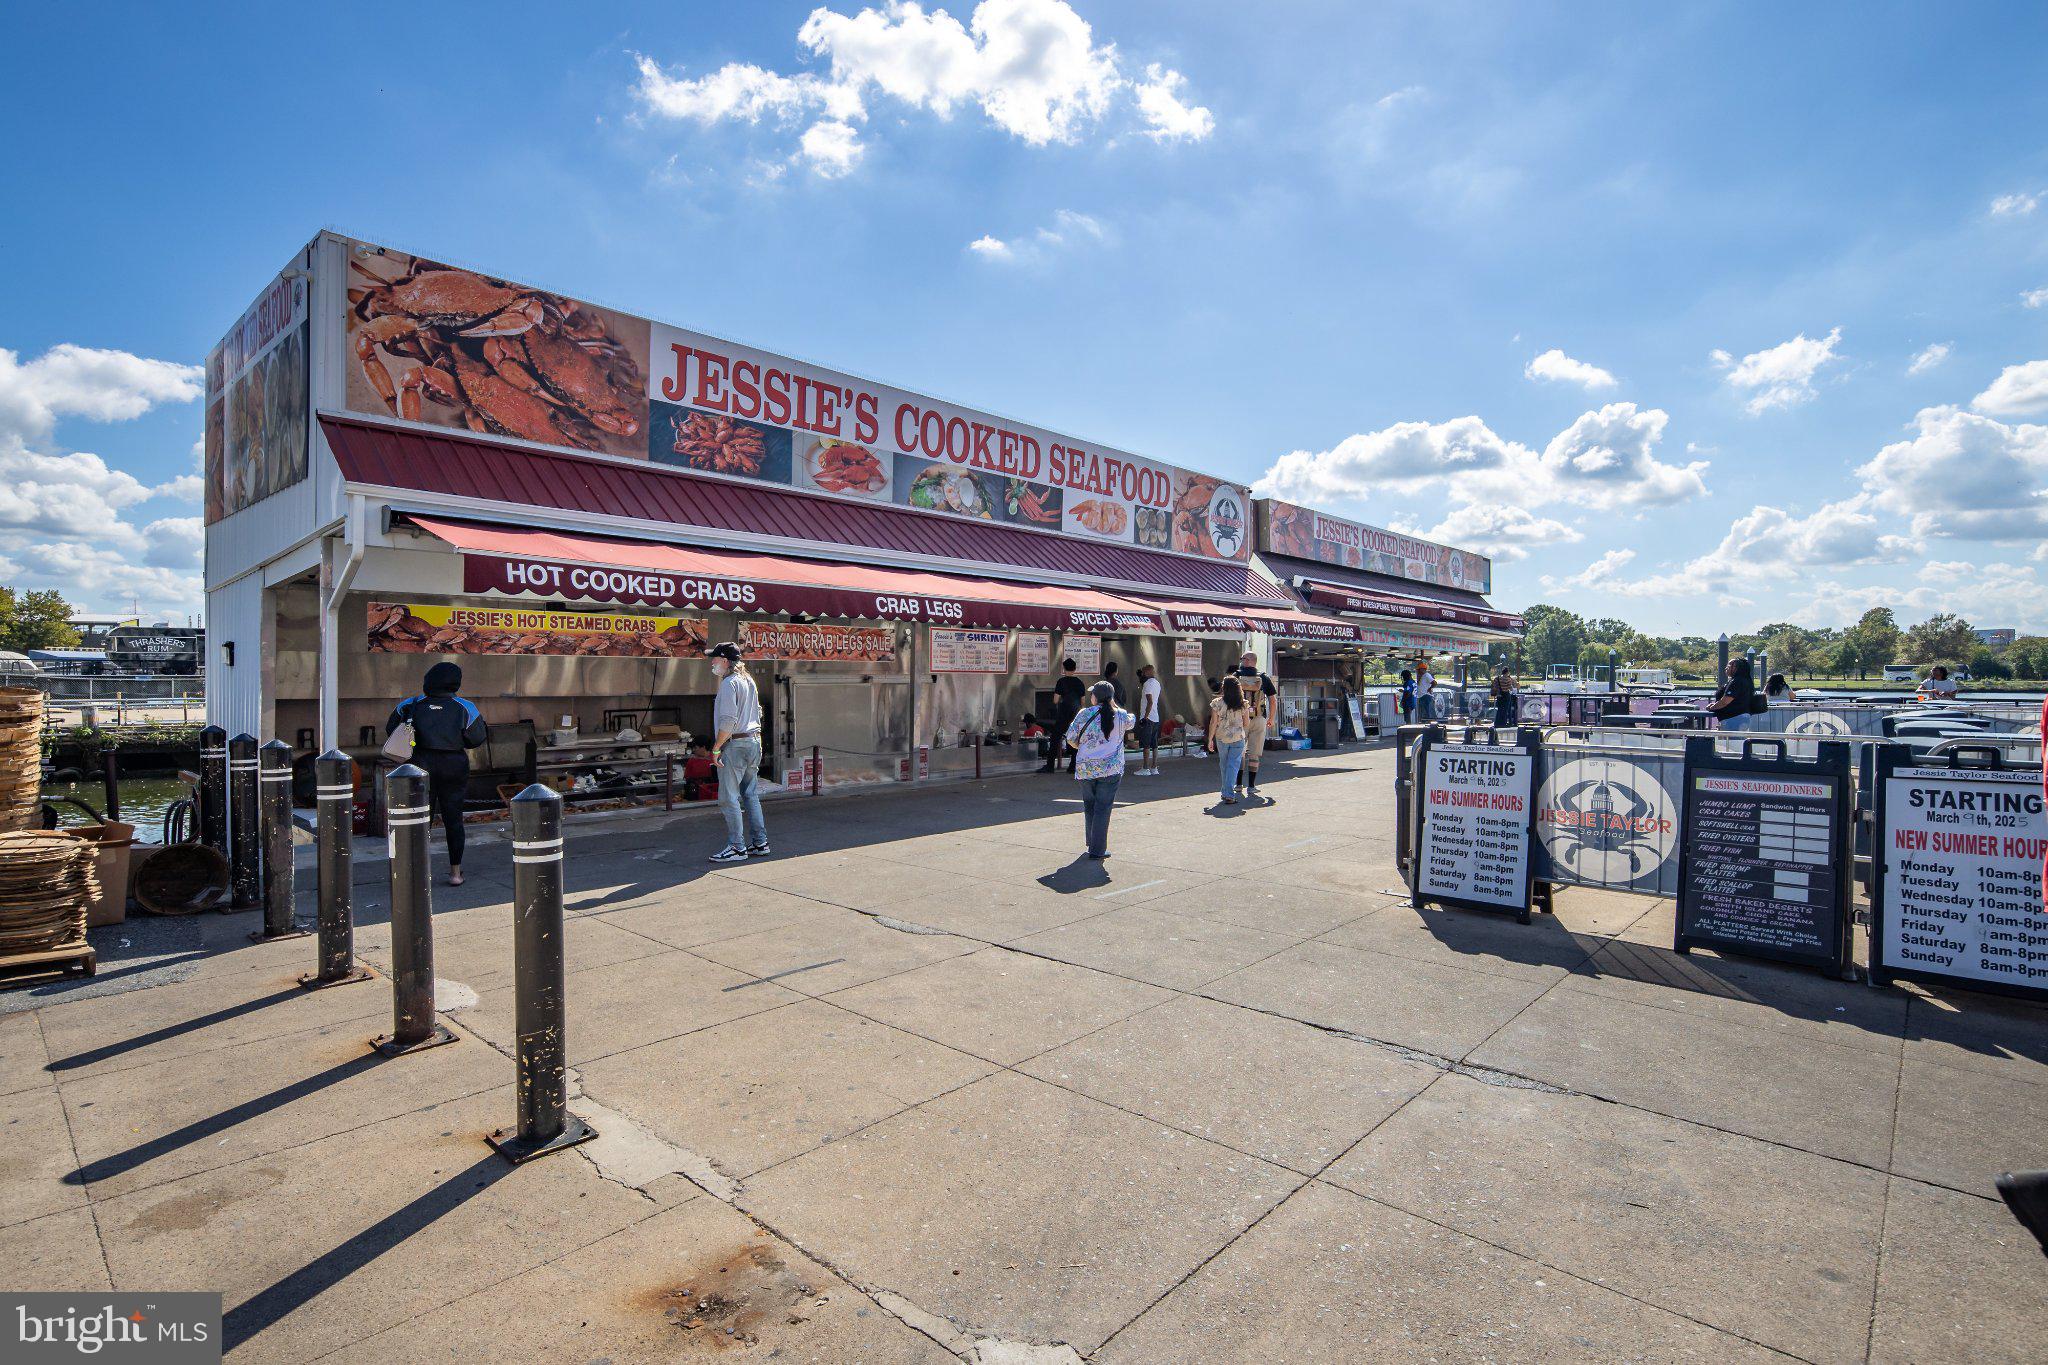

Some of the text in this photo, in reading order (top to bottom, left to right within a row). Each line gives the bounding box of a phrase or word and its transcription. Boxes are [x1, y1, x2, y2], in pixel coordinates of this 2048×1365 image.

[662, 343, 1171, 508] JESSIE'S COOKED SEAFOOD
[1316, 517, 1437, 564] JESSIE'S COOKED SEAFOOD
[506, 562, 756, 603] HOT COOKED CRABS
[875, 596, 963, 619] CRAB LEGS
[448, 610, 656, 633] JESSIE'S HOT STEAMED CRABS
[1069, 611, 1151, 626] SPICED SHRIMP
[1176, 614, 1245, 628] MAINE LOBSTER
[1270, 621, 1286, 633] BAR
[967, 633, 1005, 643] SHRIMP
[1293, 622, 1354, 637] HOT COOKED CRABS
[129, 637, 186, 648] THRASHER'S
[744, 630, 891, 651] ALASKAN CRAB LEGS SALE
[1439, 758, 1516, 777] STARTING
[1912, 769, 2039, 781] Jessie Taylor Seafood
[1448, 775, 1468, 785] March
[1705, 780, 1823, 796] JESSIE'S SEAFOOD DINNERS
[1430, 789, 1523, 812] NEW SUMMER HOURS
[1699, 800, 1756, 810] JUMBO LUMP
[1761, 802, 1826, 813] Sandwich Platters
[1909, 788, 2043, 815] STARTING
[1432, 812, 1520, 829] Monday 10am-8pm
[1539, 808, 1672, 834] JESSIE TAYLOR
[1699, 808, 1751, 818] CRAB CAKES
[1927, 810, 1960, 824] March
[1995, 814, 2029, 828] 2025
[1432, 823, 1519, 840] Tuesday 10am-8pm
[1580, 827, 1626, 839] Seafood
[1698, 820, 1739, 830] SOFTSHELL
[1431, 834, 1519, 852] Wednesday 10am-8pm
[1698, 831, 1756, 843] FRIED OYSTERS
[1895, 829, 2047, 860] NEW SUMMER HOUR
[1431, 845, 1518, 864] Thursday 10am-8pm
[1698, 844, 1742, 854] FRIED FISH
[1430, 856, 1455, 868] Friday
[1695, 860, 1751, 872] FRIED SHRIMP
[1738, 857, 1768, 865] FLOUNDER
[1430, 867, 1513, 887] Saturday 8am-8pm
[1703, 869, 1737, 878] PLATTER
[1901, 859, 2042, 883] Monday 10am-8p
[1429, 879, 1513, 898] Sunday 8am-8pm
[1694, 877, 1753, 890] FRIED SCALLOP
[1703, 885, 1736, 894] PLATTER
[1901, 874, 2042, 899] Tuesday 10am-8p
[1702, 894, 1813, 914] FRESH BAKED DESERTS
[1715, 902, 1742, 910] SMITH
[1901, 889, 2046, 916] Wednesday 10am-8p
[1777, 916, 1814, 925] BANANA
[1901, 903, 1968, 923] Thursday
[1713, 919, 1749, 930] PLATTERS
[1750, 925, 1775, 934] Served
[1795, 932, 1818, 940] Choice
[1901, 918, 1945, 936] Friday
[1783, 935, 1804, 943] French
[1901, 933, 2048, 962] Saturday 8am-8pm
[1901, 949, 2048, 978] Sunday 8am-8pm
